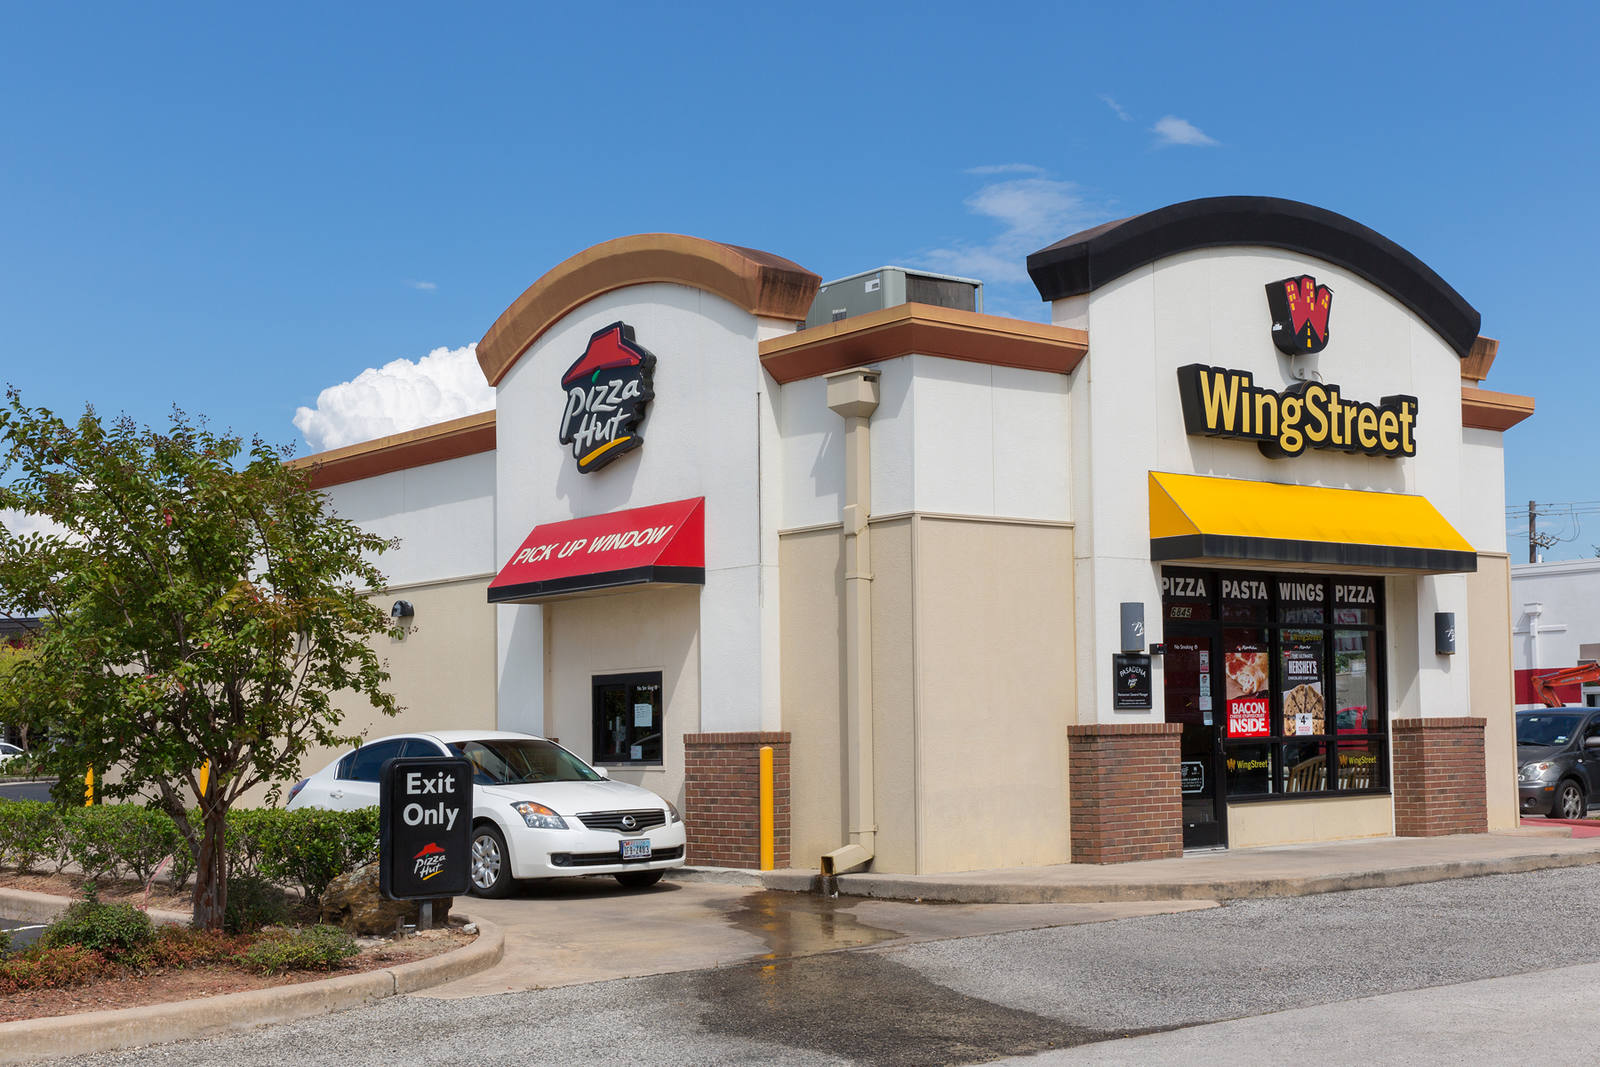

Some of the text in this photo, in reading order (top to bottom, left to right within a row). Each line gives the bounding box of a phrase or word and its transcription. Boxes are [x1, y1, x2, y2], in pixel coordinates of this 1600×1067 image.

[561, 379, 641, 439] Pizza
[1199, 370, 1414, 453] WingStreet
[573, 407, 632, 457] Hut
[512, 524, 674, 565] PICK UP WINDOW
[1161, 577, 1375, 603] PIZZA PASTA WINGS PIZZA
[1171, 607, 1192, 618] 6845
[1288, 660, 1318, 674] HERSHEY'S
[1236, 759, 1268, 771] WingStreet
[406, 771, 456, 795] Exit
[402, 802, 460, 831] Only
[413, 854, 447, 874] Pizza
[419, 863, 443, 879] Hut
